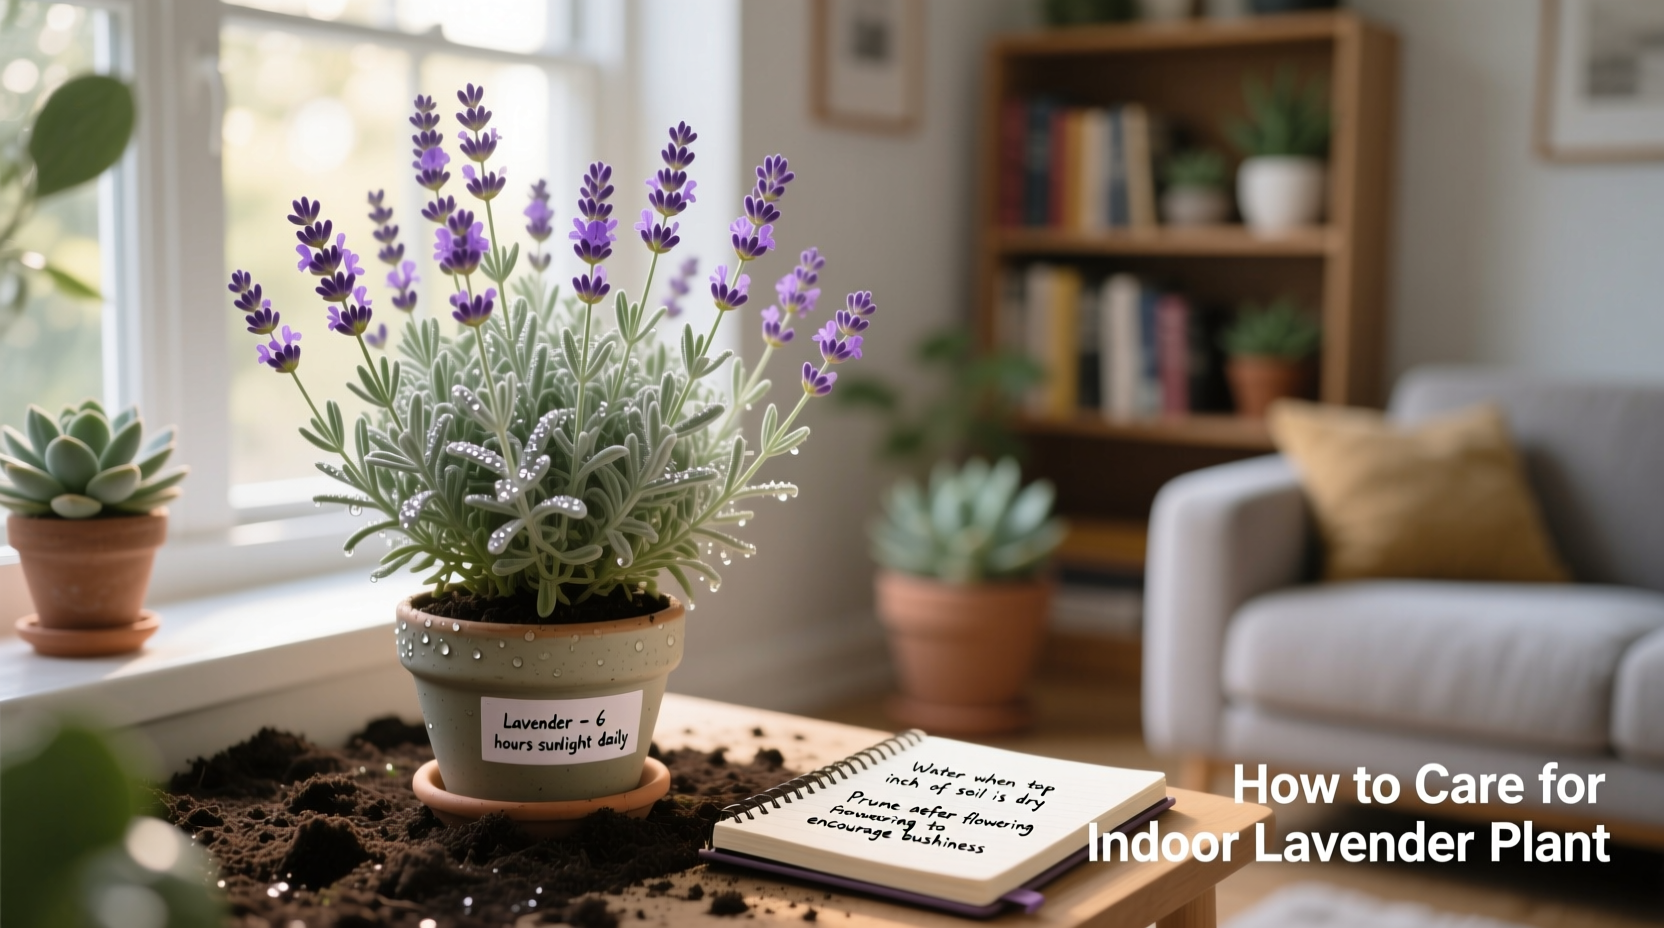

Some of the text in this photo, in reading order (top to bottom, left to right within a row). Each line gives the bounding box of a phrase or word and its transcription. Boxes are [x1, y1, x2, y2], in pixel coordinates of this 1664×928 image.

[504, 713, 573, 729] Lavender
[596, 710, 605, 726] 6
[495, 729, 628, 755] hours sunlight daily
[886, 774, 1045, 812] inch of soil is dry
[975, 774, 1015, 787] when
[1027, 780, 1056, 797] top
[807, 816, 985, 854] encourage bushiness
[927, 821, 945, 831] to
[962, 811, 1034, 836] flowering
